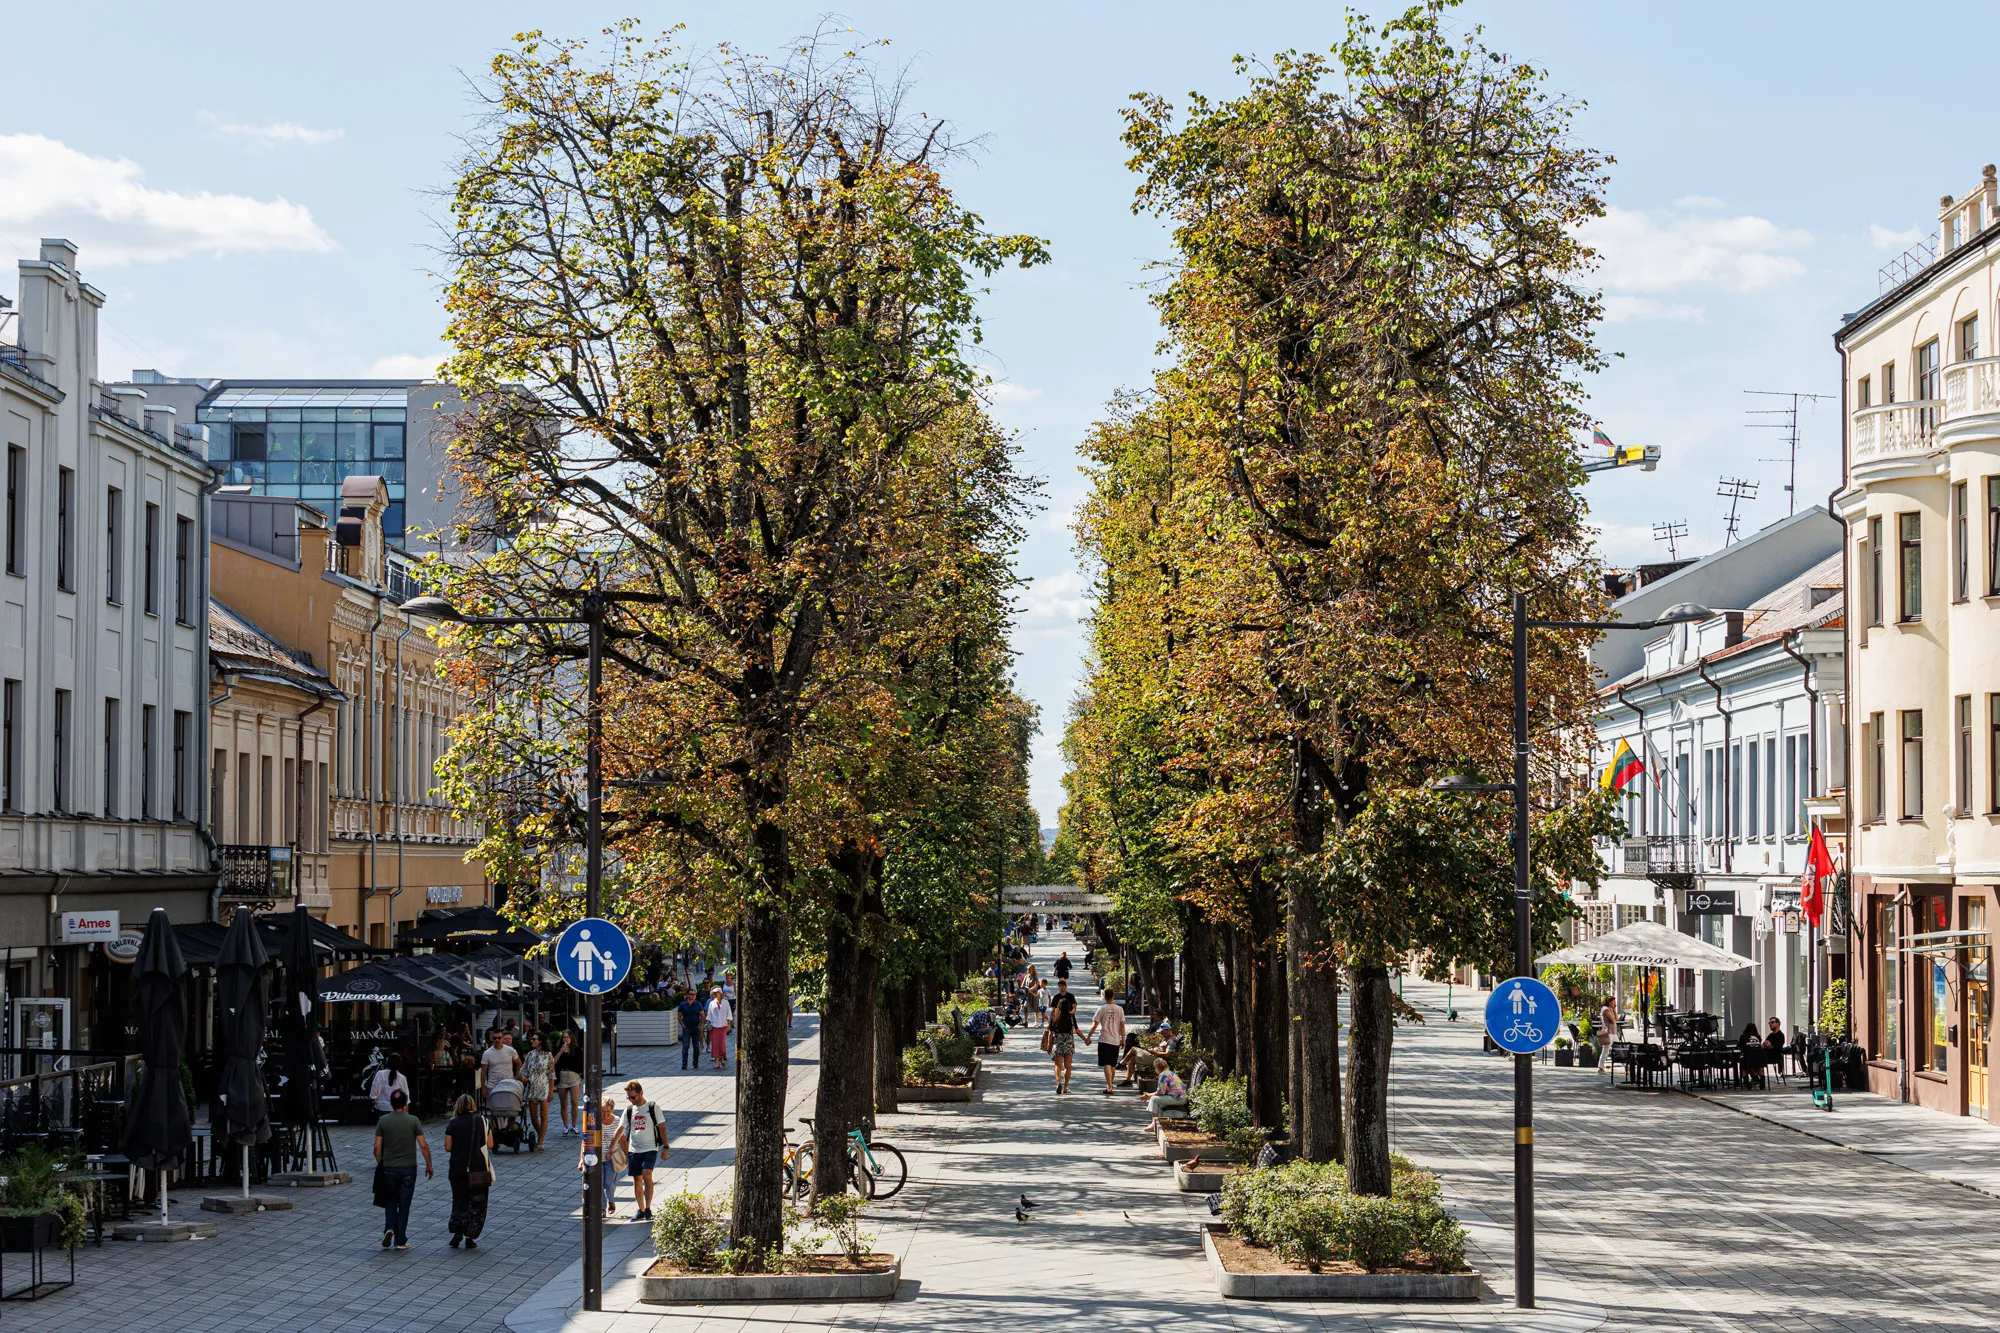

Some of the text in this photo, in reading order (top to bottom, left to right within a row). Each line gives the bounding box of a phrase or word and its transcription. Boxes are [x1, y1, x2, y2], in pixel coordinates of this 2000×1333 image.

[78, 918, 111, 929] Ames
[1584, 952, 1679, 967] Vilkmergės
[319, 991, 401, 1002] Vilkmergės
[350, 1025, 398, 1040] MANGAL
